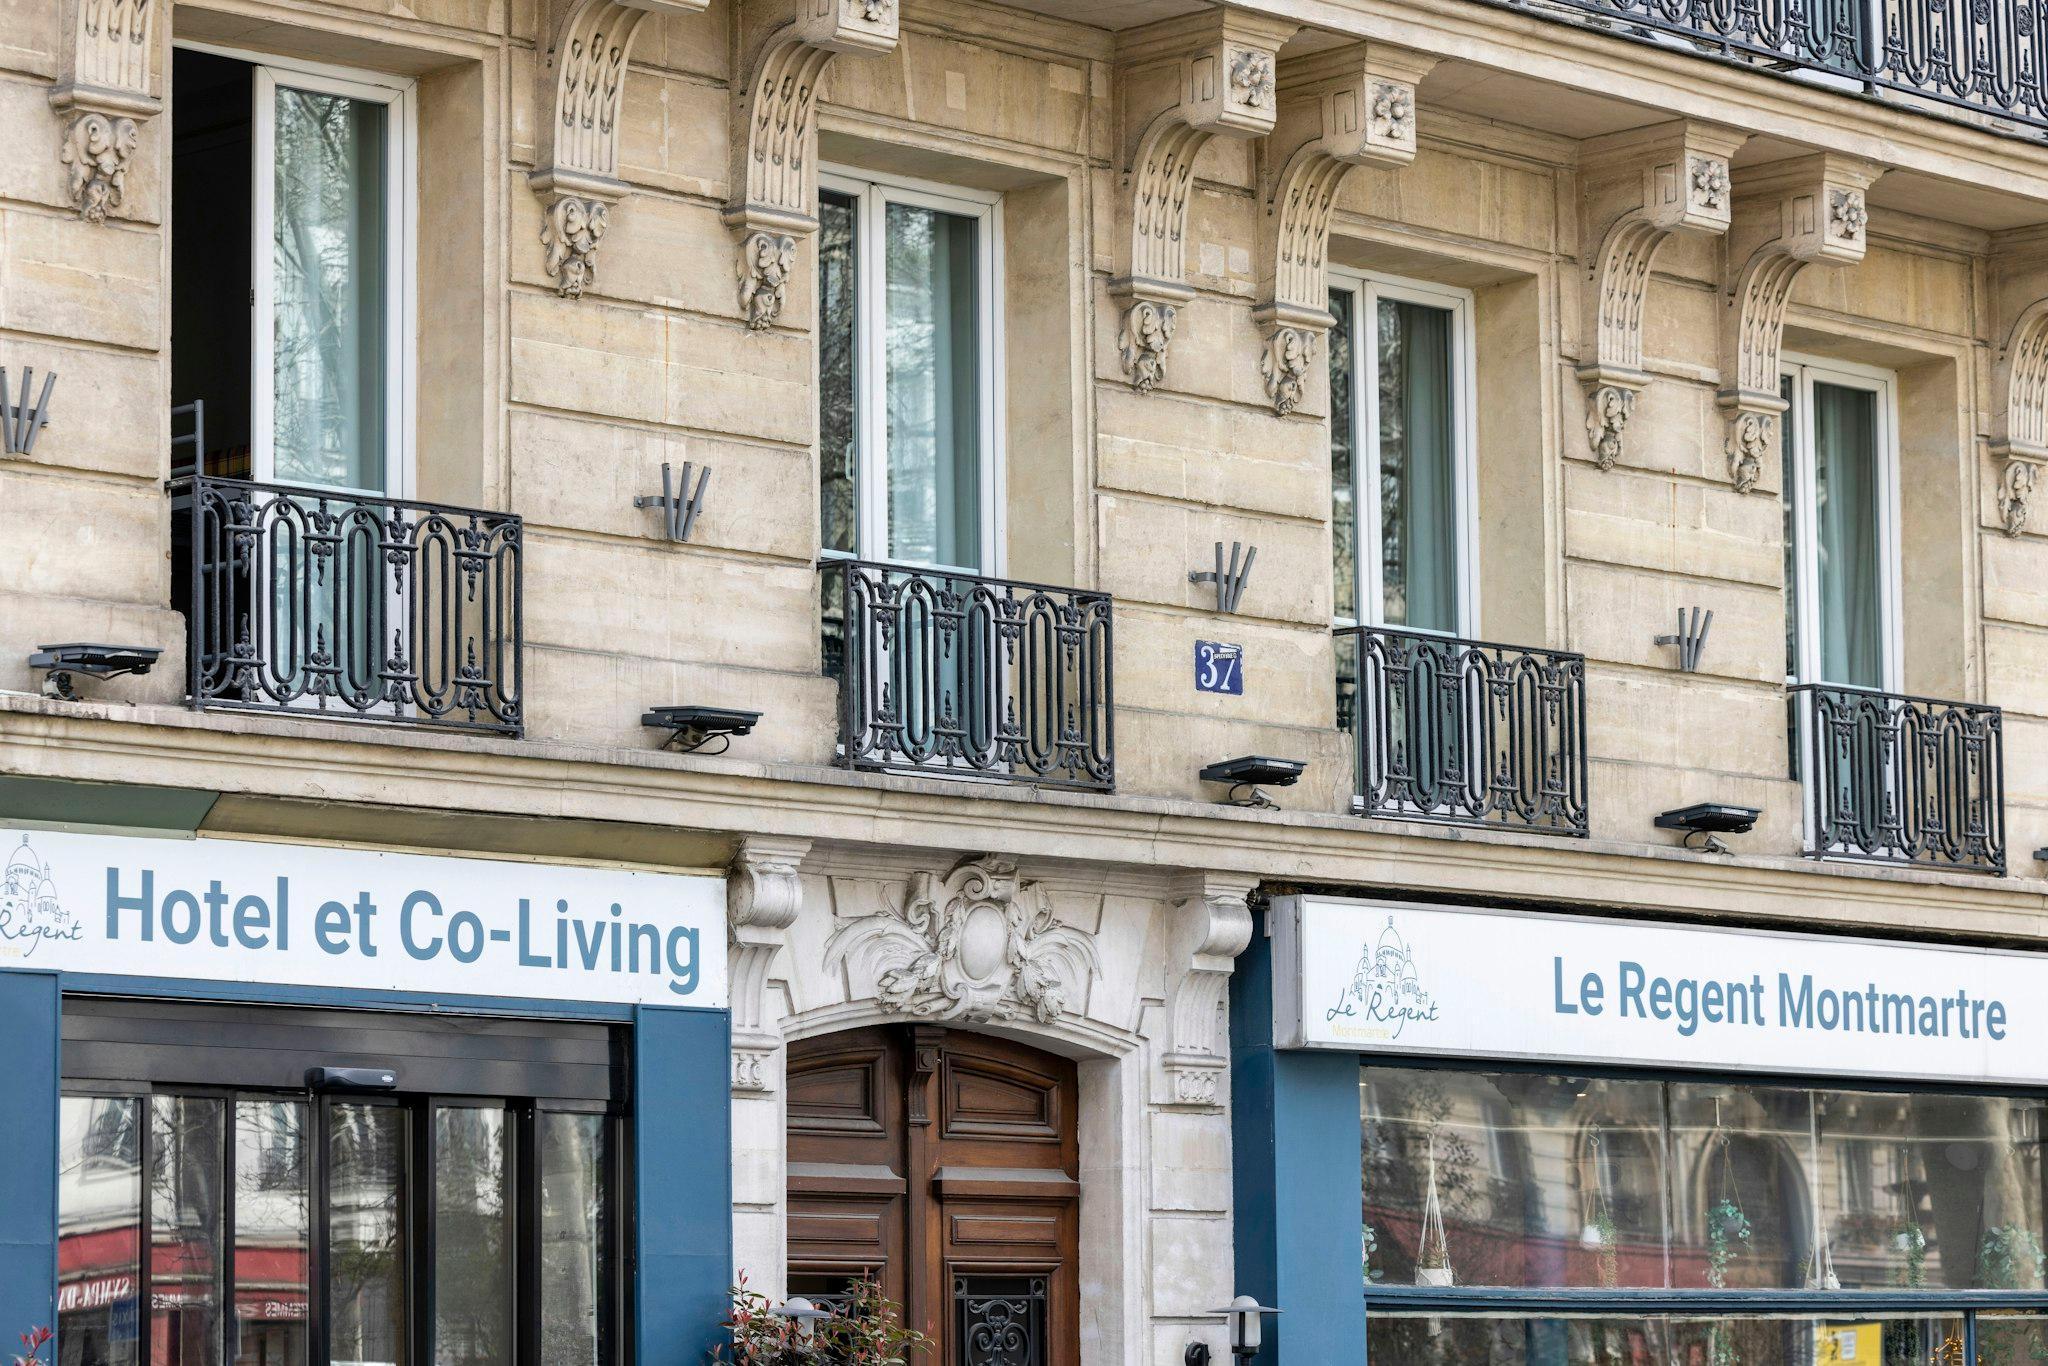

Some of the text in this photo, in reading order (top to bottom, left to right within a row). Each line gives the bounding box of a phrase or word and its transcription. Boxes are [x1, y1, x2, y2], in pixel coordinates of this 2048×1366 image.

[1200, 645, 1238, 691] 37
[105, 866, 700, 996] Hotel et Co-Living
[1326, 987, 1440, 1040] Le Regent
[1554, 956, 2007, 1041] Le Regent Montmartre
